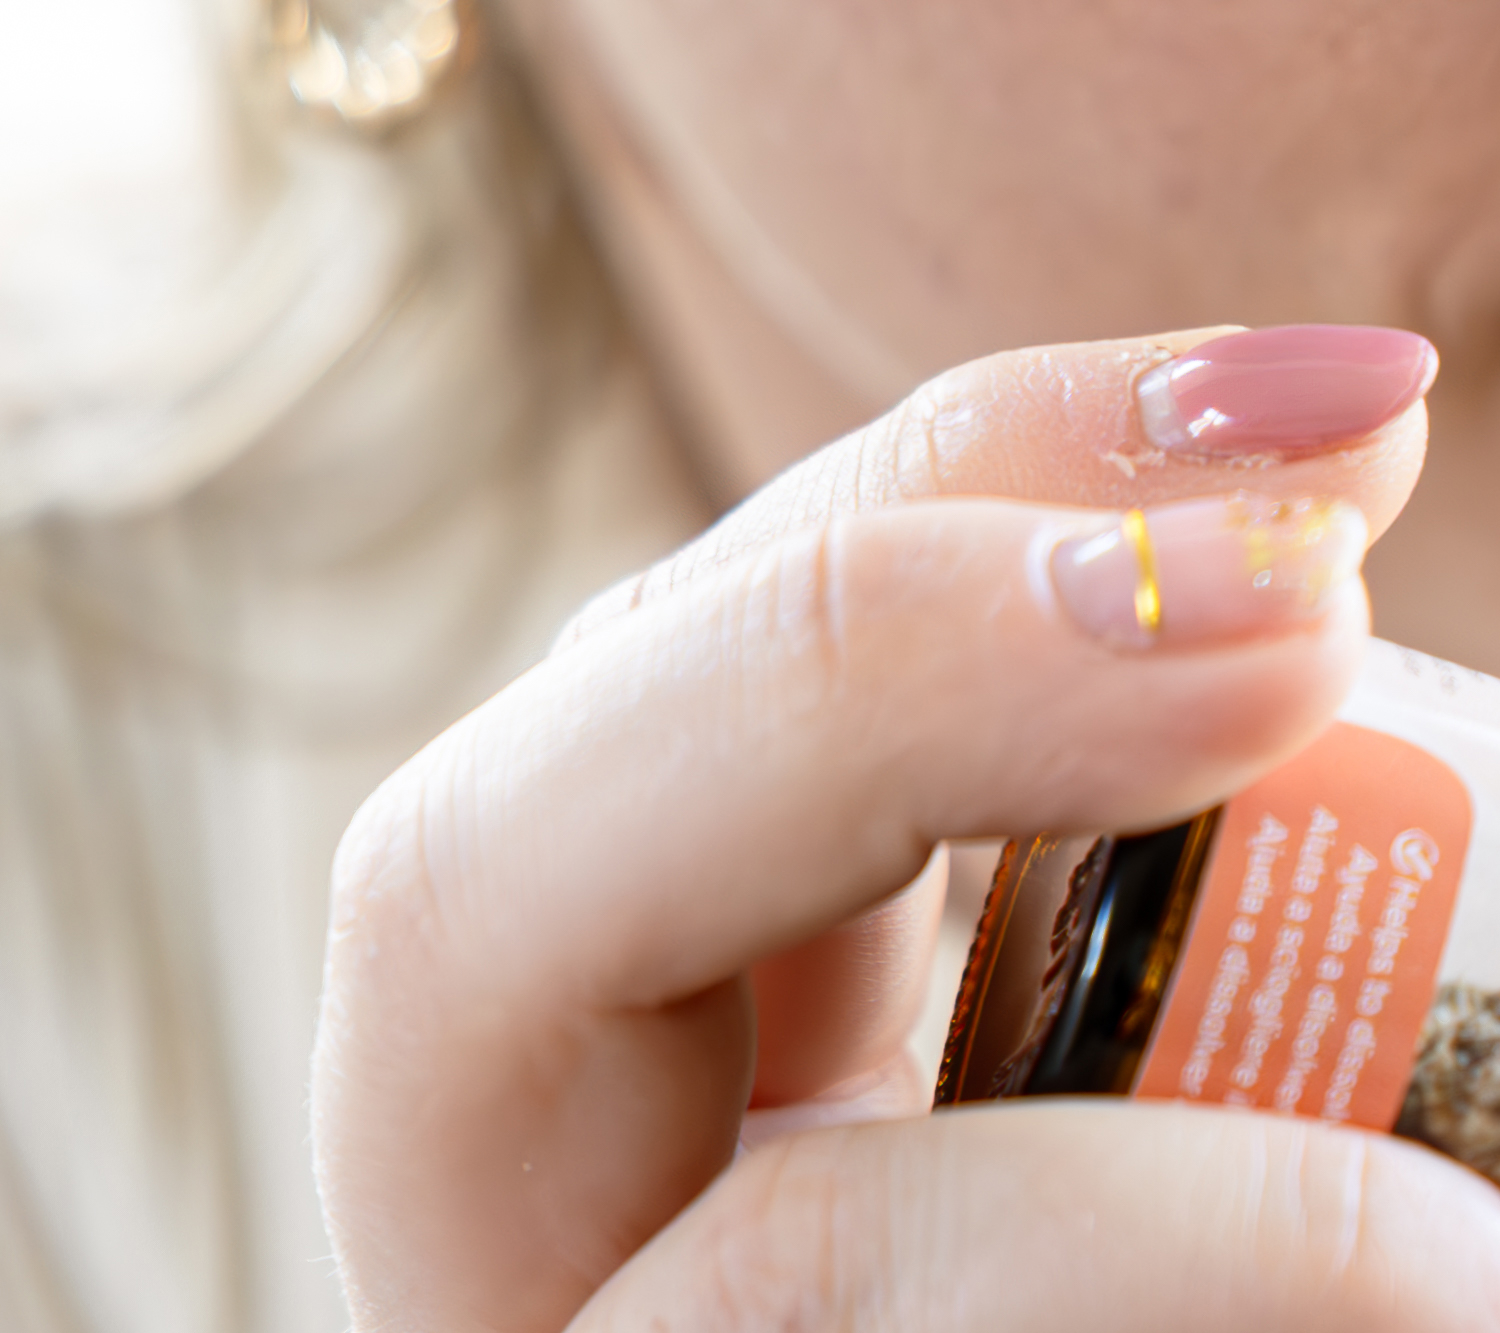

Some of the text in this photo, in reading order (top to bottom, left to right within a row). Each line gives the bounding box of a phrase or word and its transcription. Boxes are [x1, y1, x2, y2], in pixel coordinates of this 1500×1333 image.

[1291, 804, 1339, 895] Aiuta
[1324, 842, 1378, 953] Ayuda
[1179, 811, 1290, 1098] Ajuda a dissolver
[1283, 894, 1313, 922] a
[1315, 953, 1345, 982] a
[1321, 875, 1422, 1122] Helps to dissol
